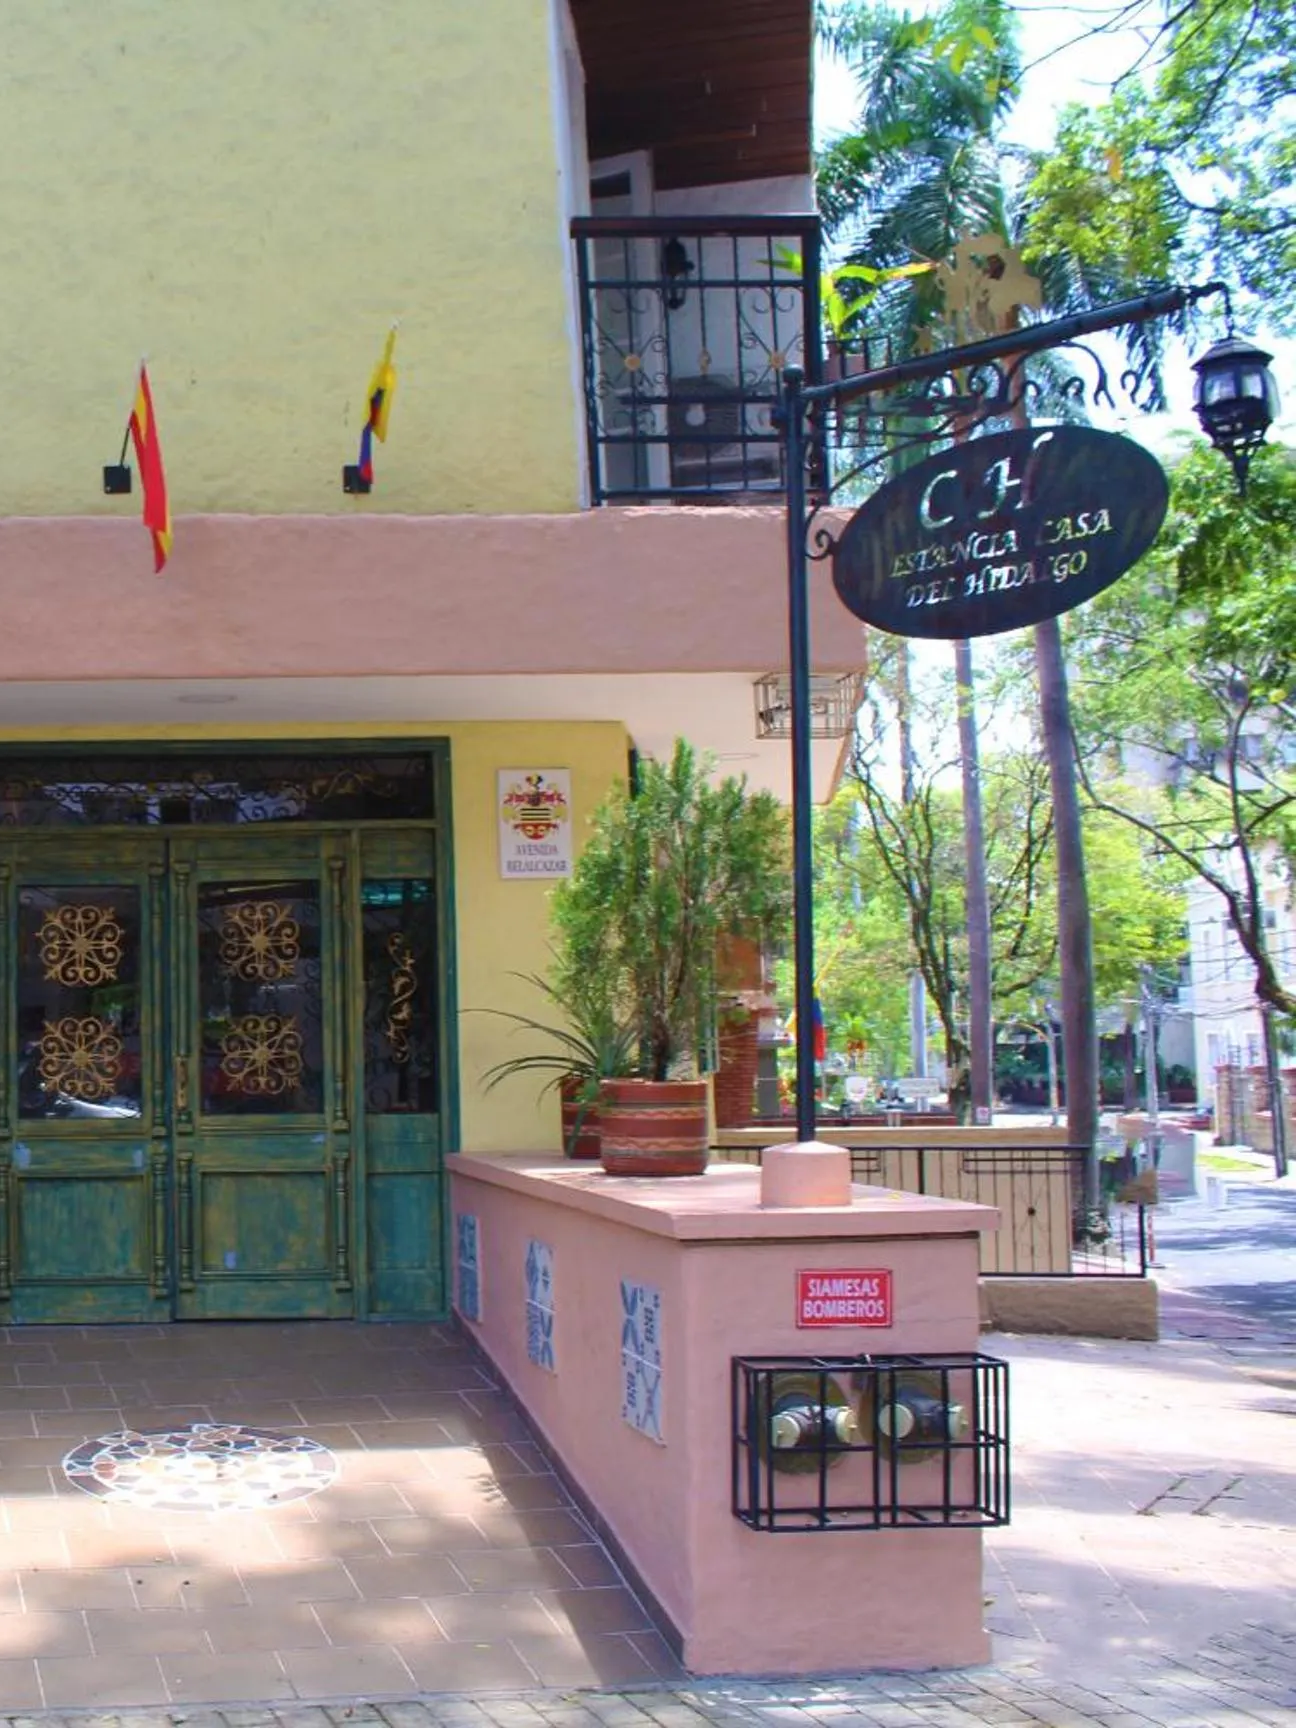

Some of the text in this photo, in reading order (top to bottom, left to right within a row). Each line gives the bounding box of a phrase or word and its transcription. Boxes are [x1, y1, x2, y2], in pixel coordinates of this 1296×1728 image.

[888, 530, 1018, 578] ESTANCIA
[906, 579, 955, 607] DEL
[807, 1278, 880, 1297] SIAMESAS
[804, 1299, 885, 1318] BOMBEROS
